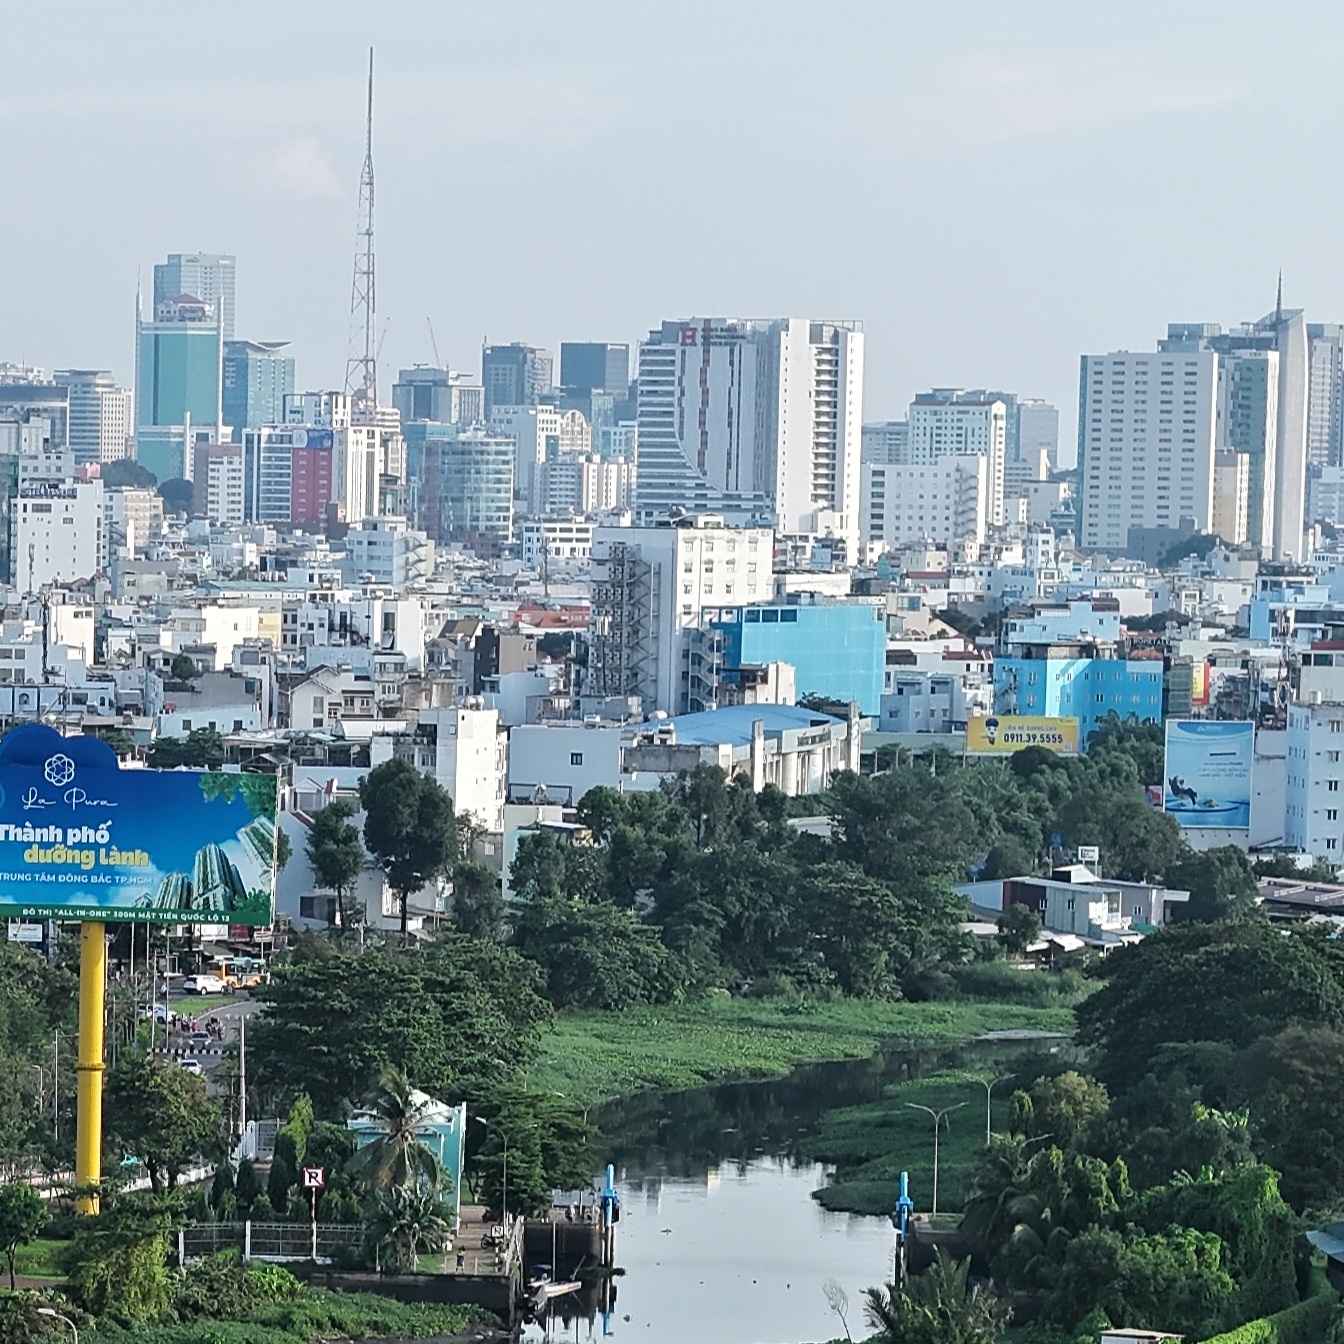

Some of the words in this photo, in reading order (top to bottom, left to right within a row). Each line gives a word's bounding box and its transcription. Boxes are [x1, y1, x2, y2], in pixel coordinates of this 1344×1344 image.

[1003, 733, 1063, 744] 0911.39.5555
[22, 787, 56, 810] La
[64, 787, 119, 811] Pura
[67, 819, 113, 846] phố
[23, 843, 95, 870] dưỡng
[99, 845, 149, 867] lành
[33, 872, 56, 883] TÂM
[58, 872, 88, 883] ĐÔNG
[90, 871, 112, 884] BẮC
[180, 911, 205, 922] QUỐC
[207, 913, 219, 923] LỘ
